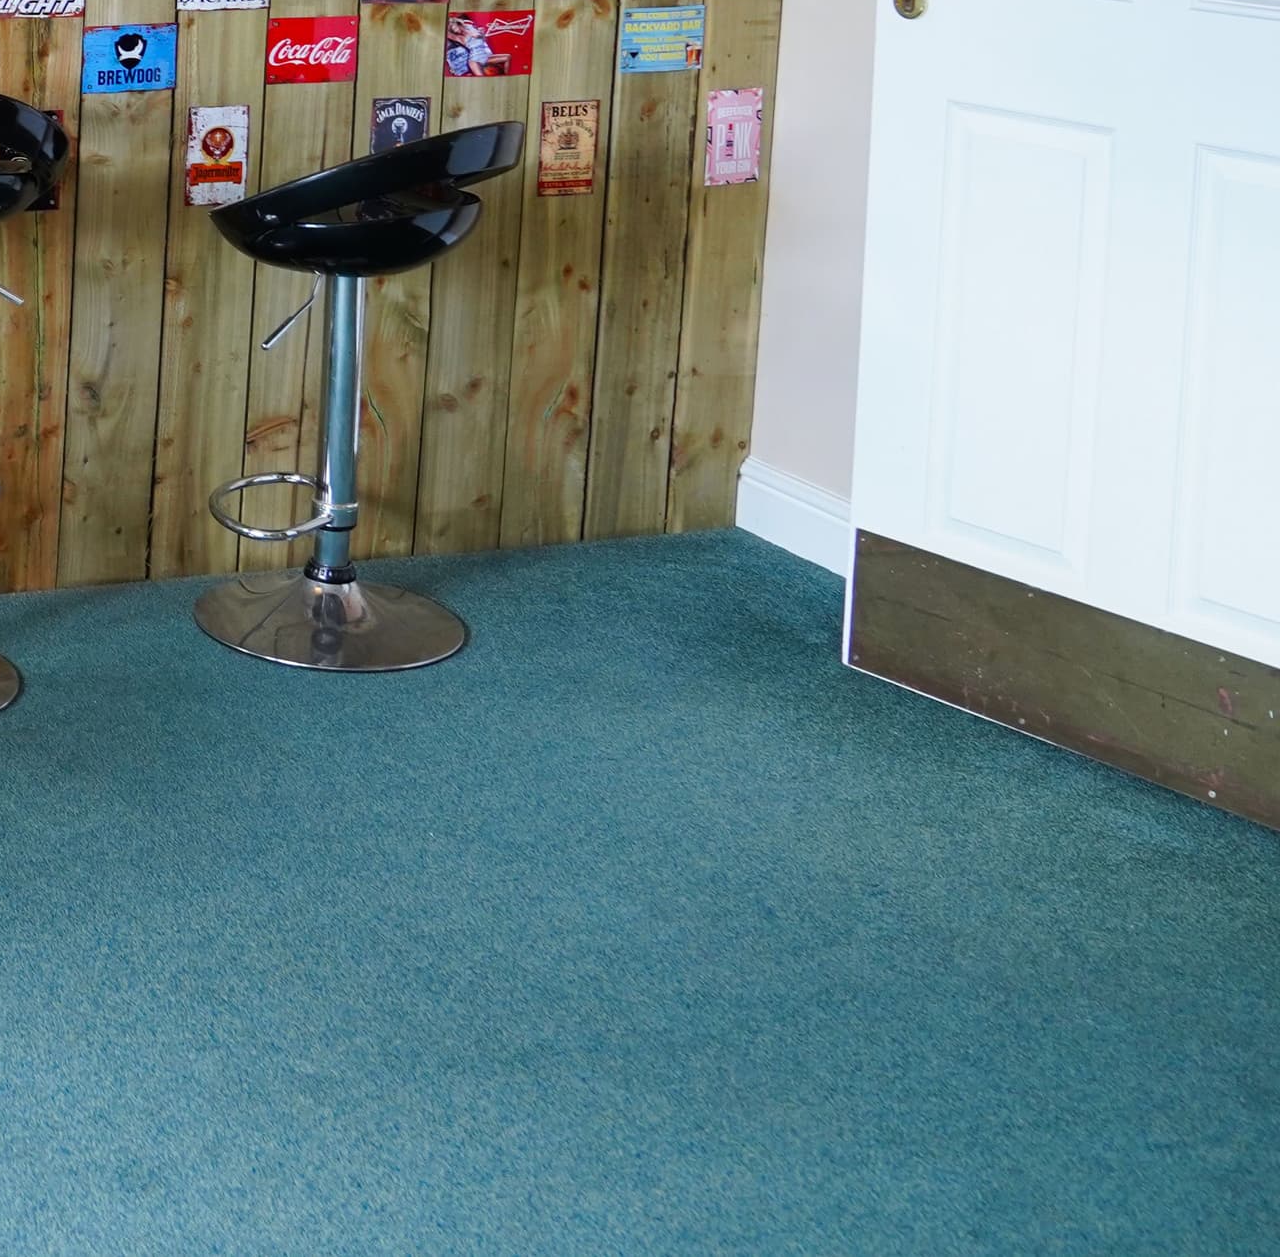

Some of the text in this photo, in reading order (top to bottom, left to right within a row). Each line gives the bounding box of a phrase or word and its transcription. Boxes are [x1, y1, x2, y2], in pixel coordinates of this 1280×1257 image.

[625, 20, 701, 33] BACKYARD BAR
[97, 68, 162, 86] BREWDOG
[375, 106, 396, 123] JACK
